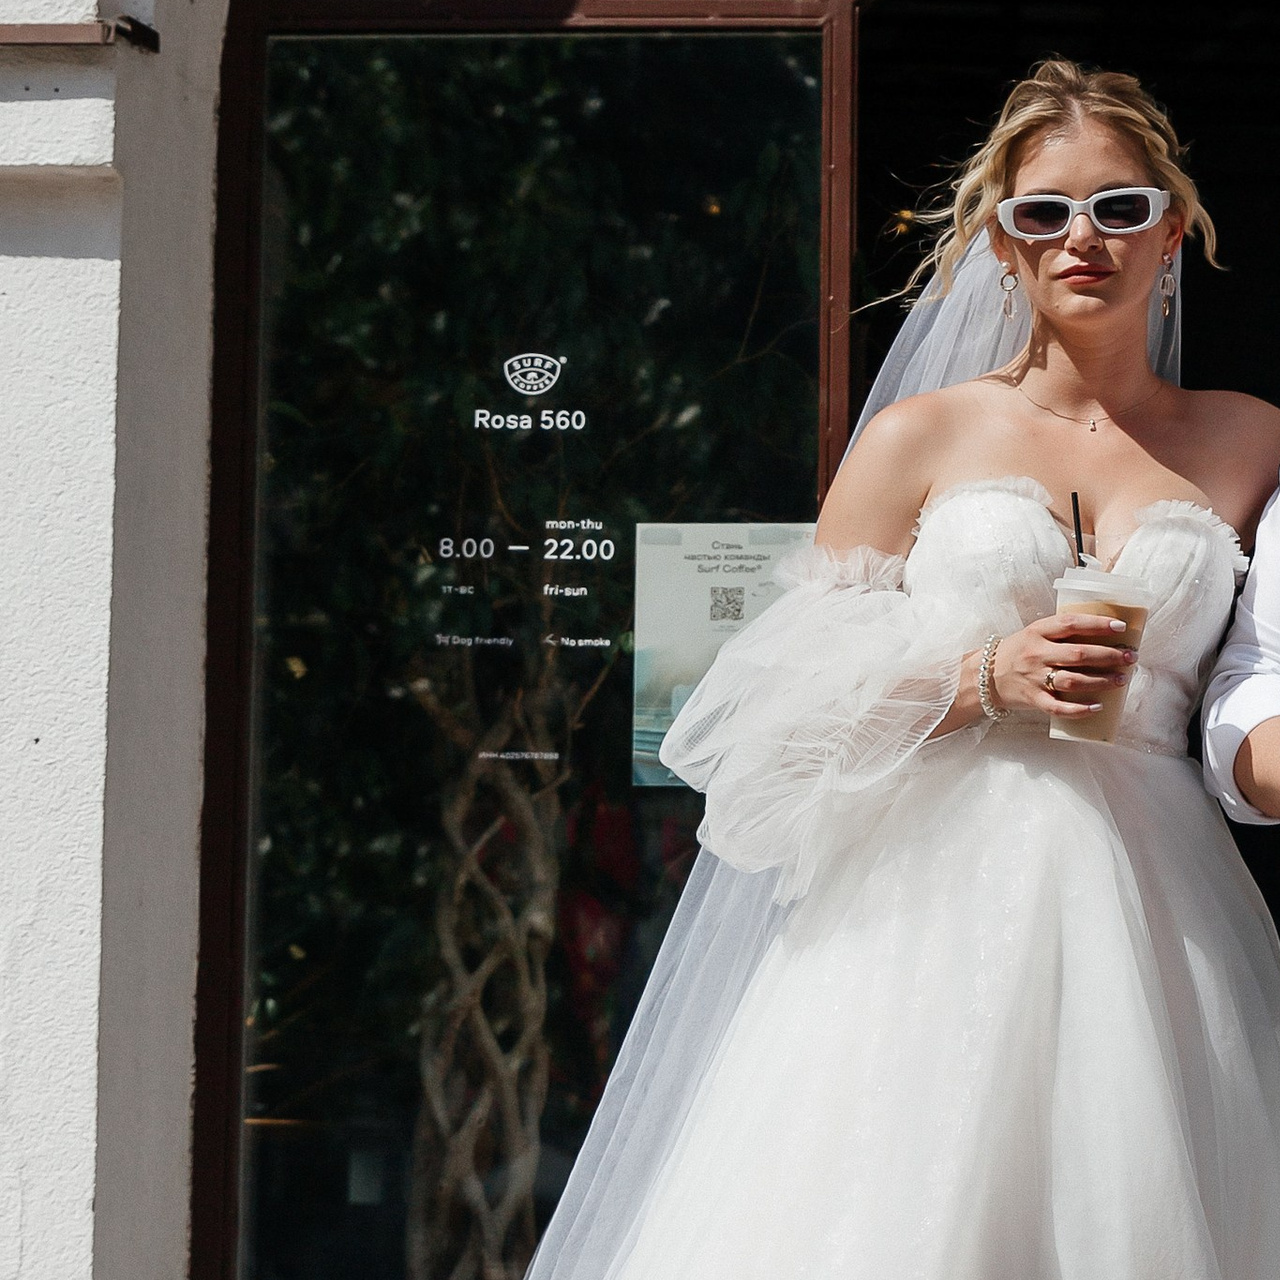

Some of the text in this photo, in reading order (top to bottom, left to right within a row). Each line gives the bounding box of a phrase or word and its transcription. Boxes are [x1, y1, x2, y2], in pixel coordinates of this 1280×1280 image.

[512, 358, 553, 370] SURF
[474, 409, 586, 430] Rosa 560
[545, 519, 603, 530] mon-thu
[439, 538, 494, 558] 8.00
[543, 539, 615, 560] 22.00
[711, 540, 743, 549] Стань
[697, 564, 720, 573] Surf
[543, 584, 587, 596] fri-sun
[452, 635, 514, 646] Dog friendly
[561, 637, 611, 647] No smoke
